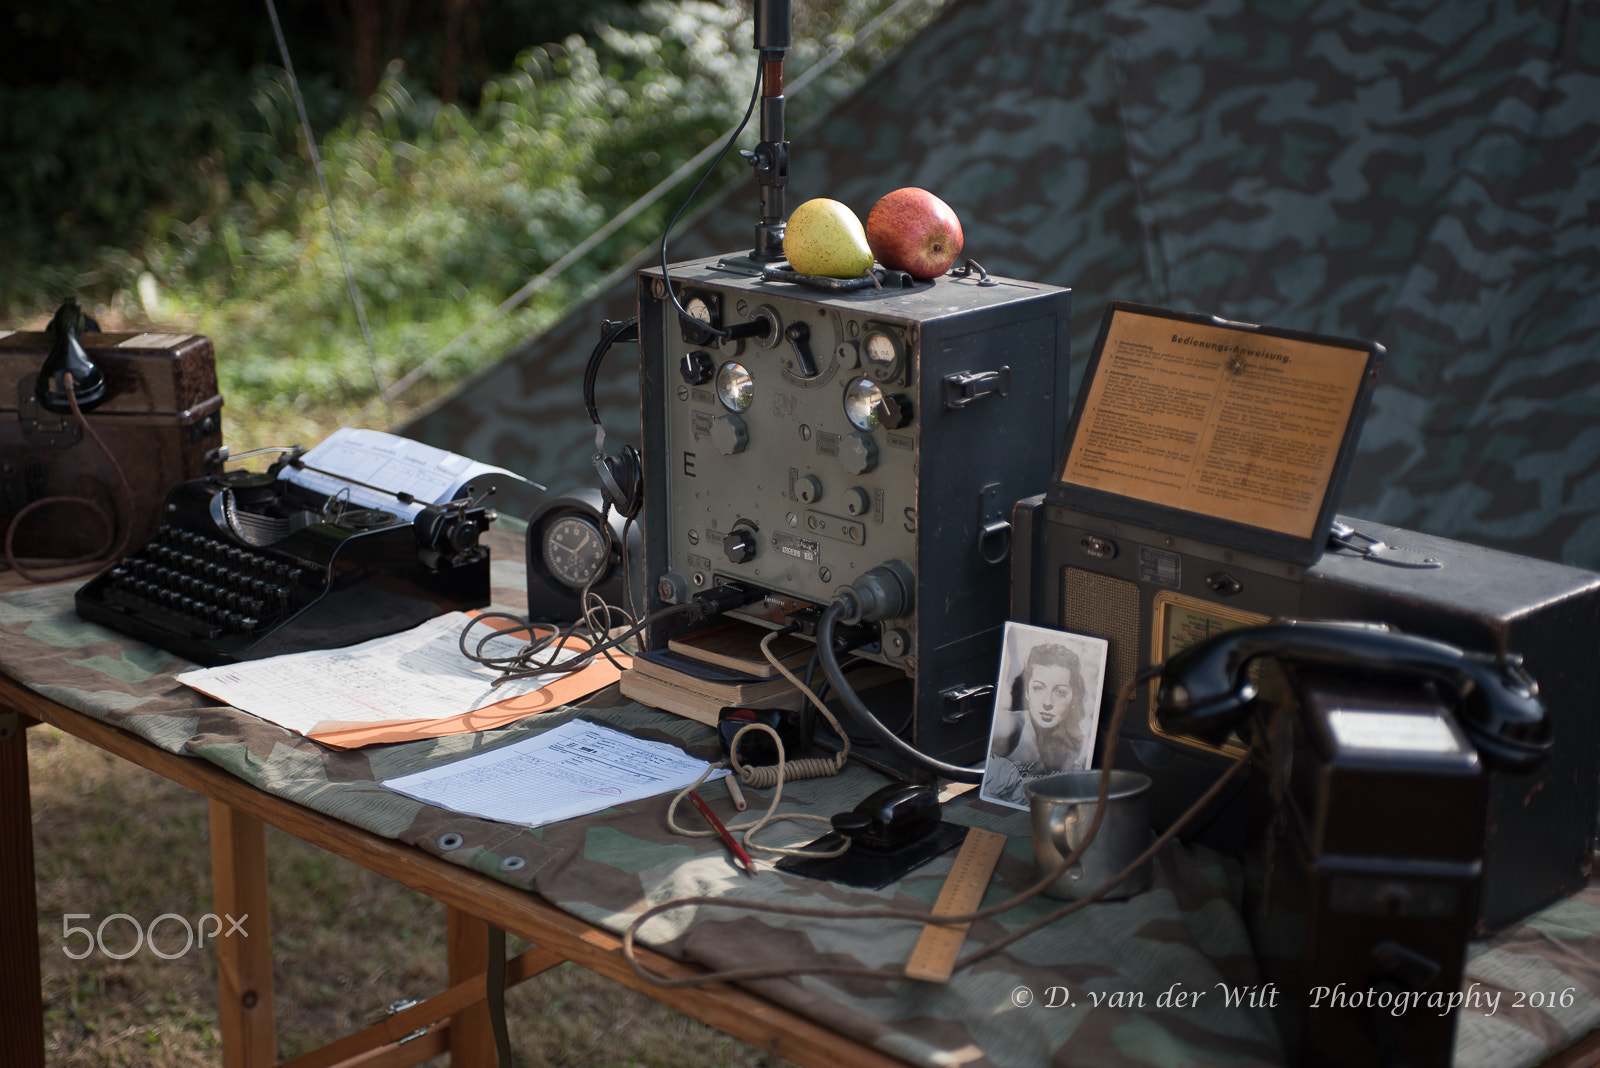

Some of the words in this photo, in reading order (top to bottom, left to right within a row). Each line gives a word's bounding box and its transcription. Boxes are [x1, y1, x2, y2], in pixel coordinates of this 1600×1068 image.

[1171, 334, 1292, 364] Bedienungs-Anweisung.
[683, 451, 697, 478] E
[903, 506, 916, 534] S
